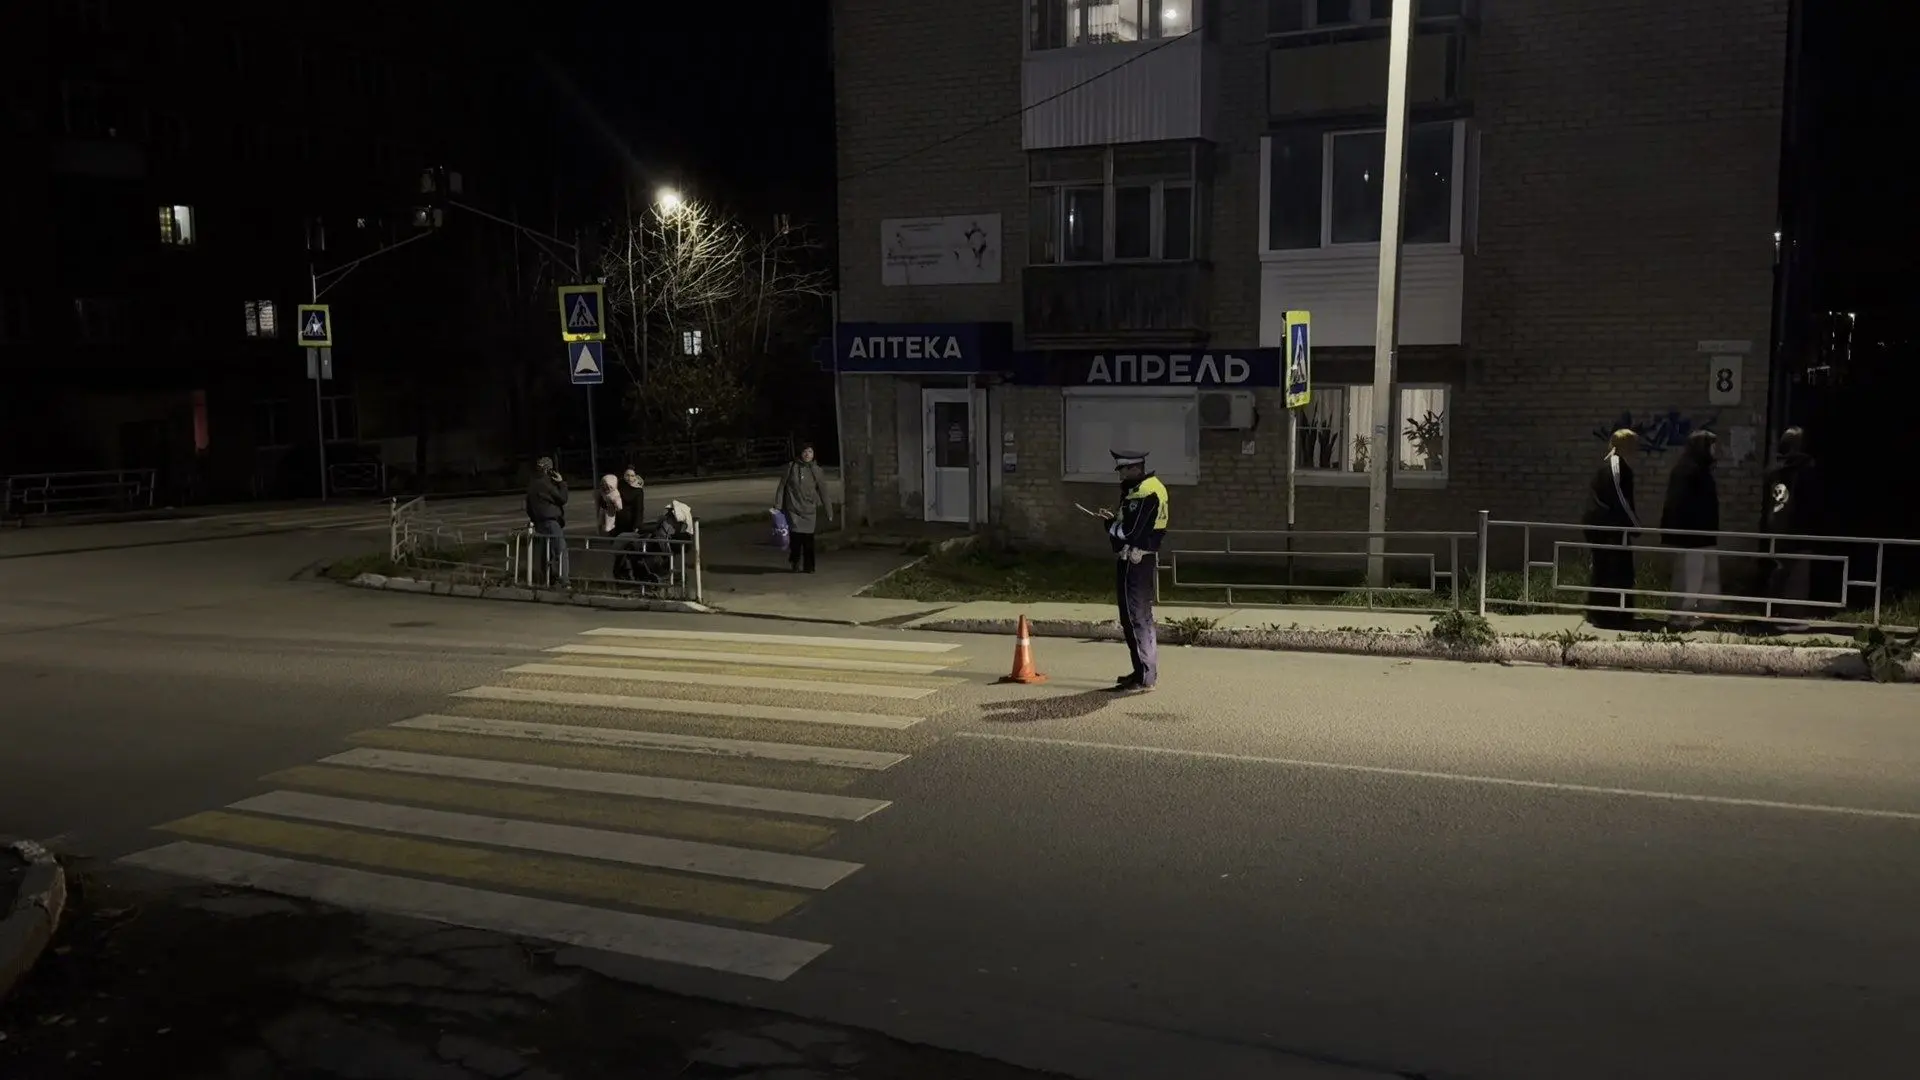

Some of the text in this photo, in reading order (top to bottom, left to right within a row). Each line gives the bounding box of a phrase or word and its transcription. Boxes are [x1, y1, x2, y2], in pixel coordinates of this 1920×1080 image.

[848, 335, 963, 359] АПТЕКА
[1087, 354, 1251, 384] АПРЕЛЬ
[1716, 368, 1733, 393] 8
